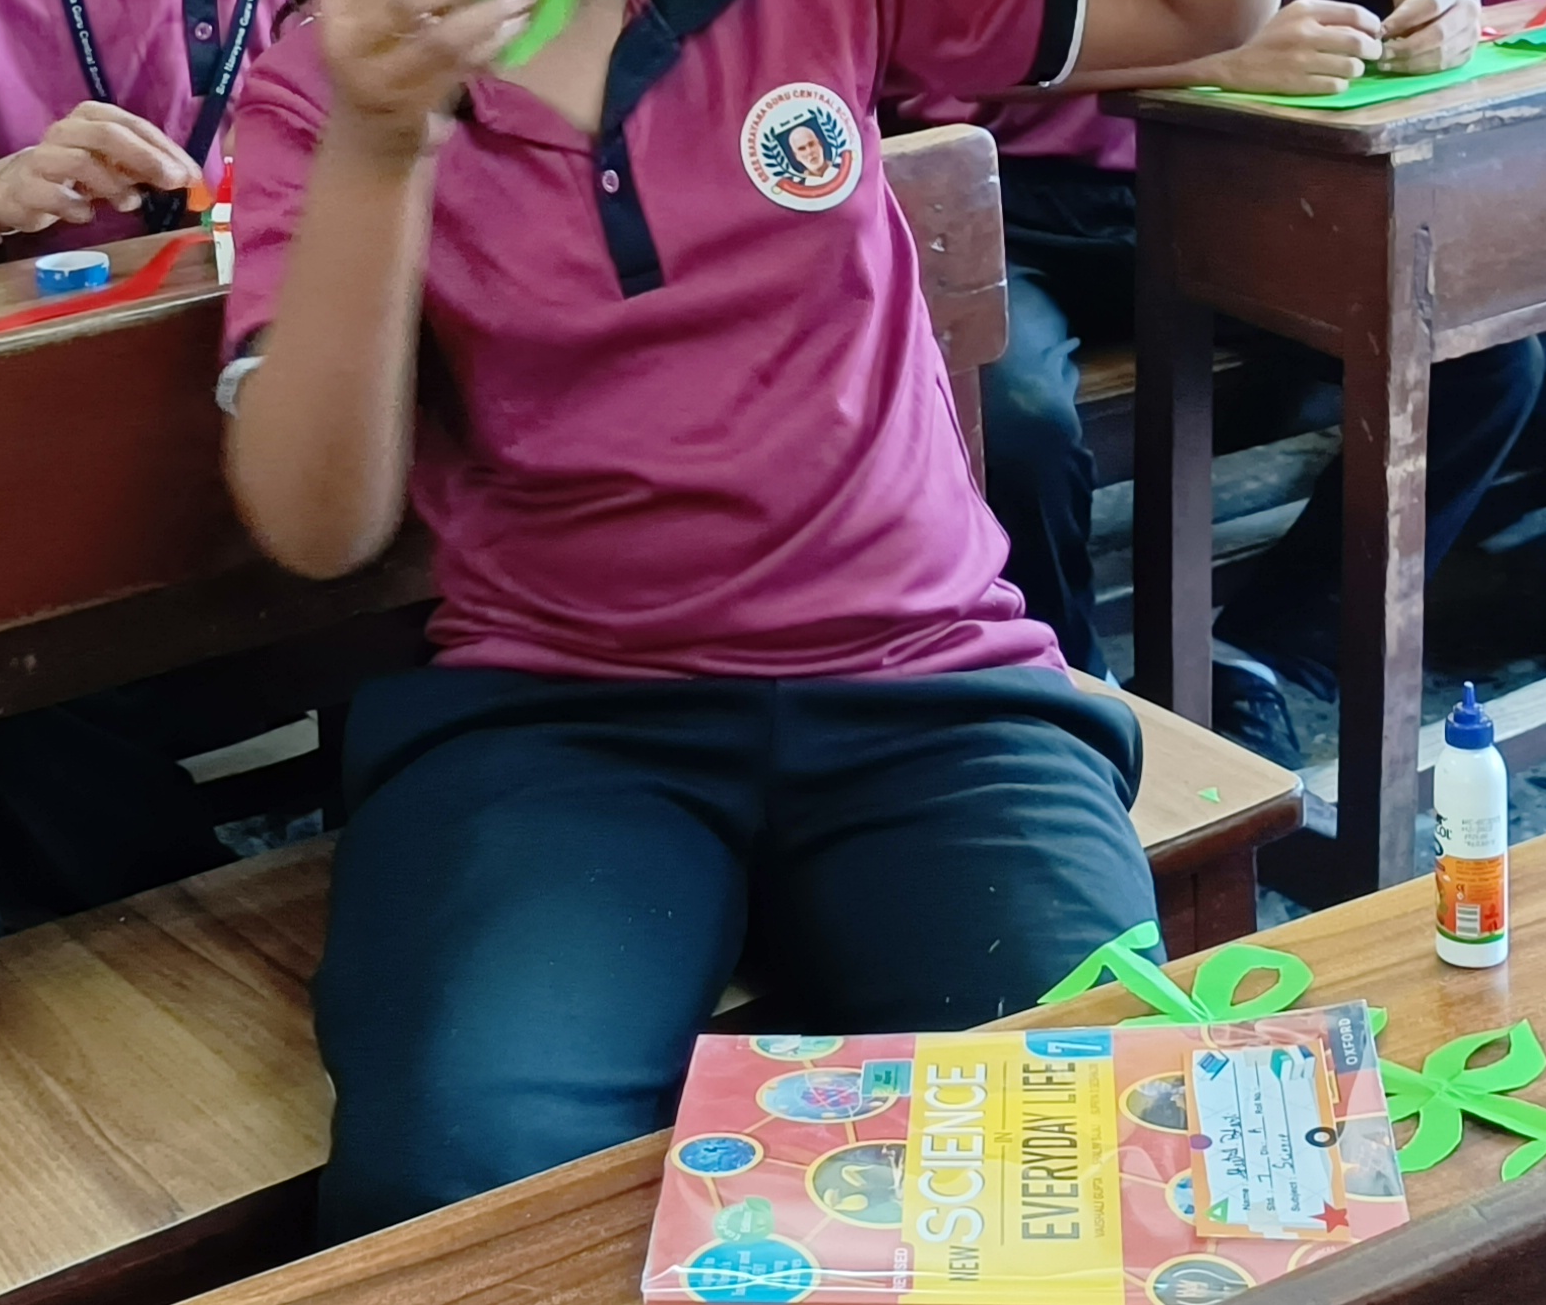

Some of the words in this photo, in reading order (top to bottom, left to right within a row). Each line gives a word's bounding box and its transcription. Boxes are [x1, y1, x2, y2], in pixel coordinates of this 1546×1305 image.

[71, 5, 84, 29] Guru
[79, 30, 96, 66] Central
[215, 72, 231, 96] Sree
[223, 26, 246, 72] Narayana
[239, 1, 253, 27] Guru
[747, 108, 768, 158] NARAYANA
[765, 91, 792, 110] GURU
[793, 89, 834, 110] CENTRAL
[1047, 1041, 1103, 1053] 7
[1338, 1017, 1359, 1066] OXFORD
[1022, 1061, 1077, 1105] LIFE
[916, 1063, 987, 1244] SCIENCE
[994, 1131, 1013, 1143] IN
[1021, 1112, 1080, 1240] EVERYDAY
[949, 1245, 980, 1282] NEW
